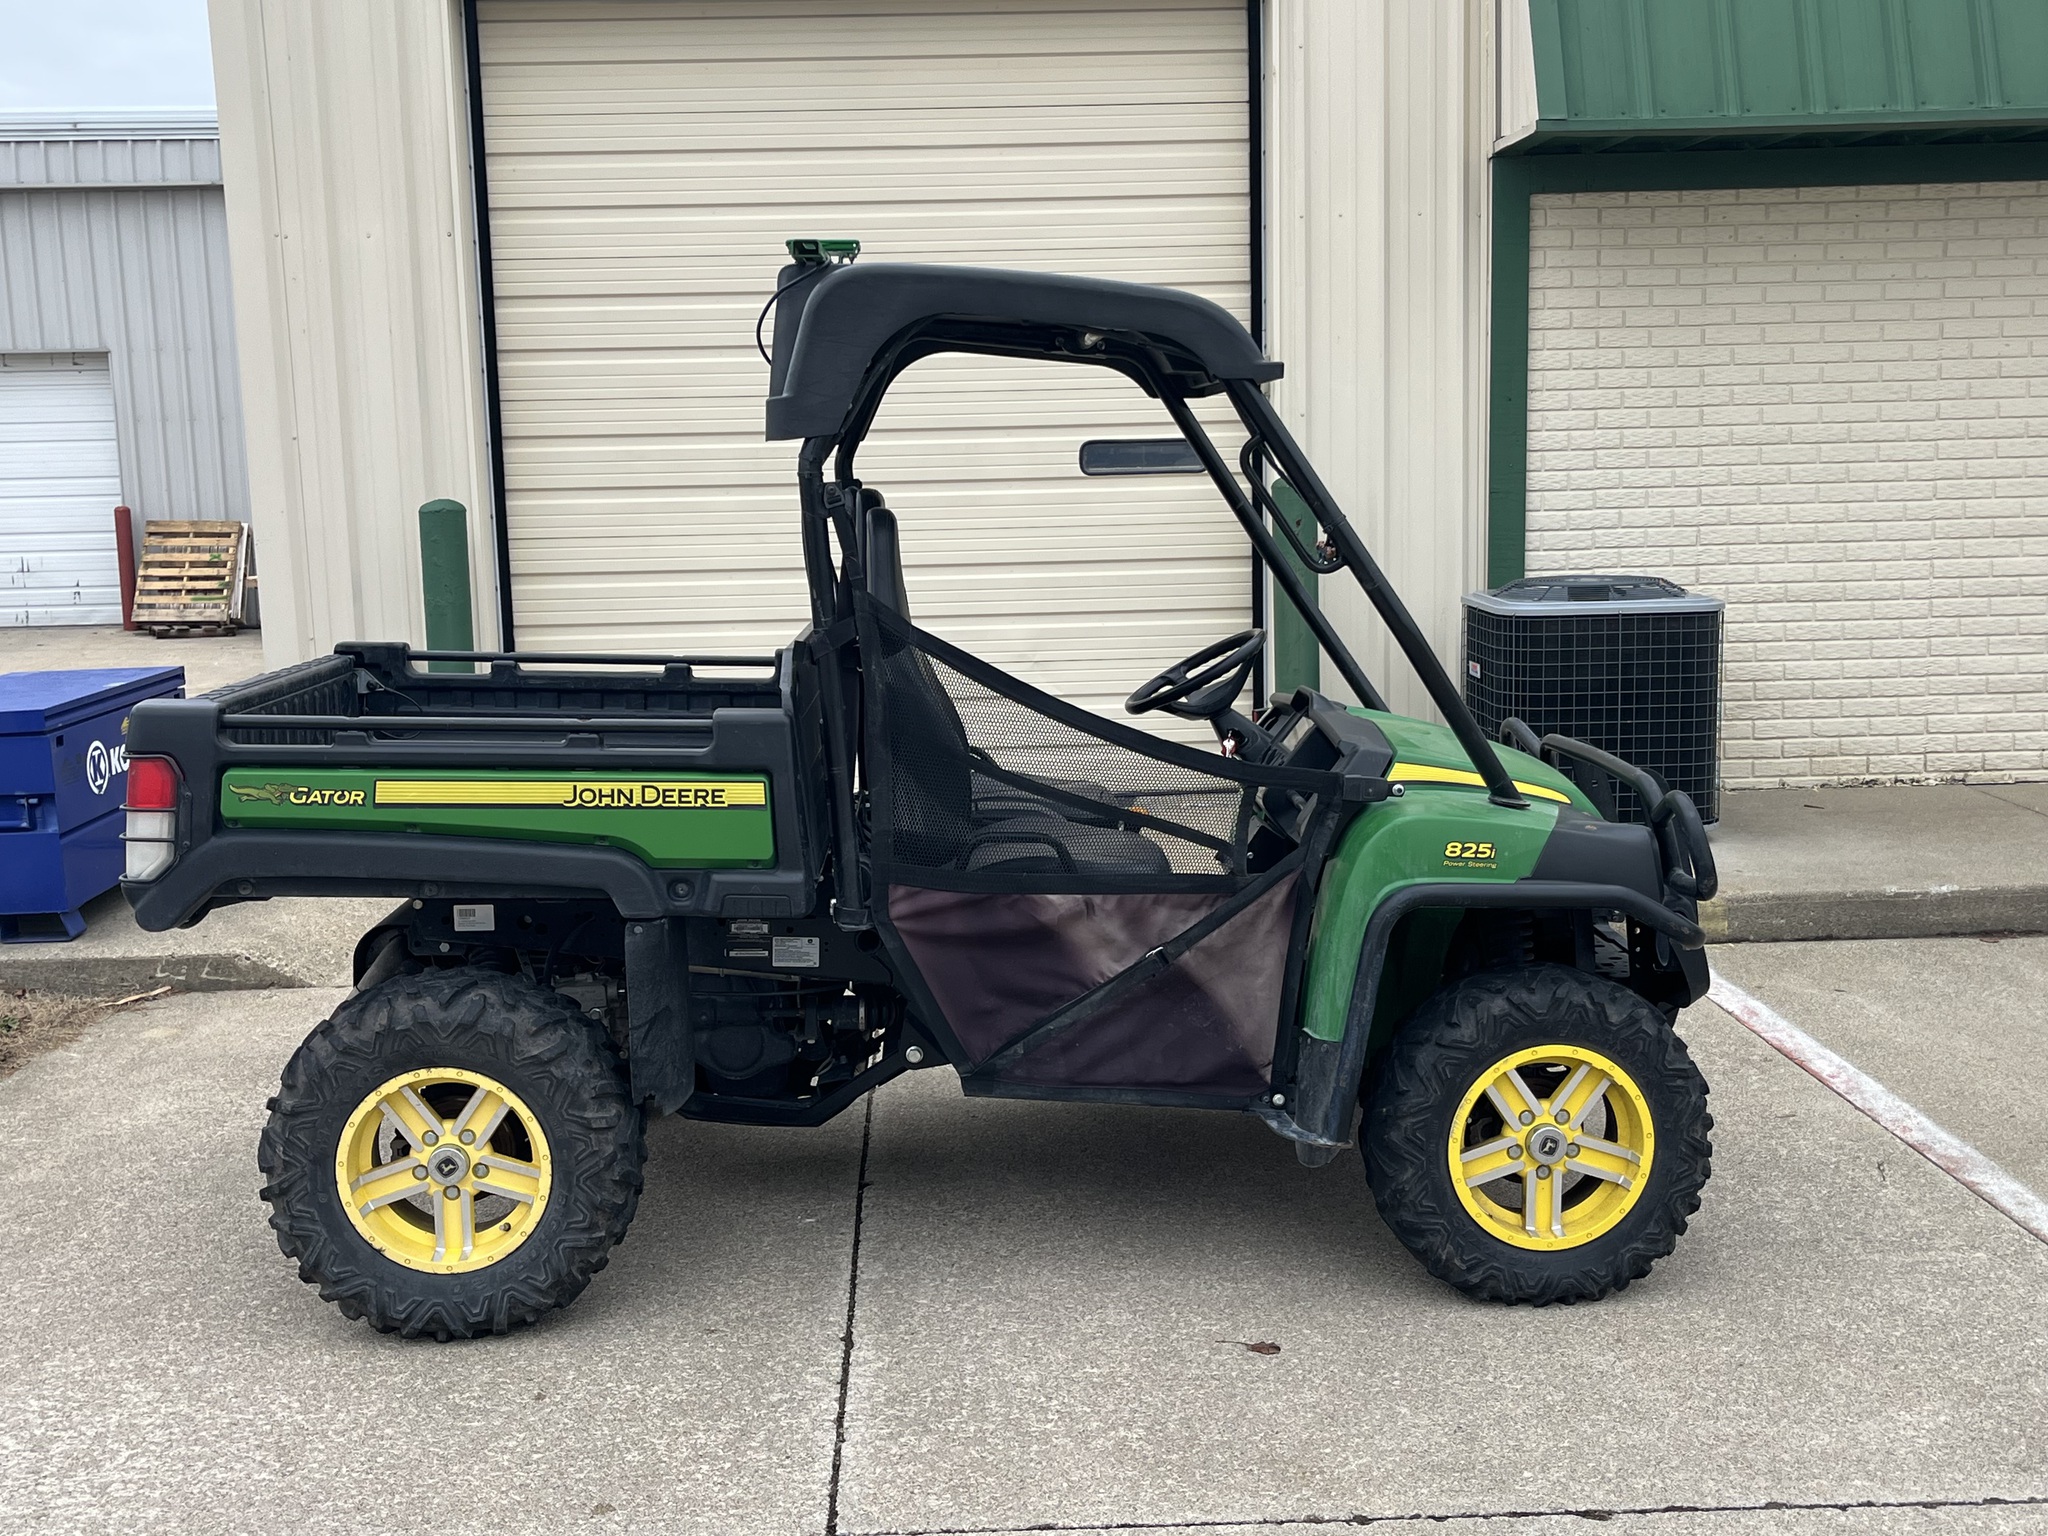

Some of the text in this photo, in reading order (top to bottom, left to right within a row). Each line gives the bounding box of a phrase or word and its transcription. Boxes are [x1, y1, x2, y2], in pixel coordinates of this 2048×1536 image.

[289, 787, 366, 805] GATOR
[563, 784, 727, 805] JOHN DEERE
[1444, 841, 1496, 859] 825i
[1467, 861, 1497, 869] Steering
